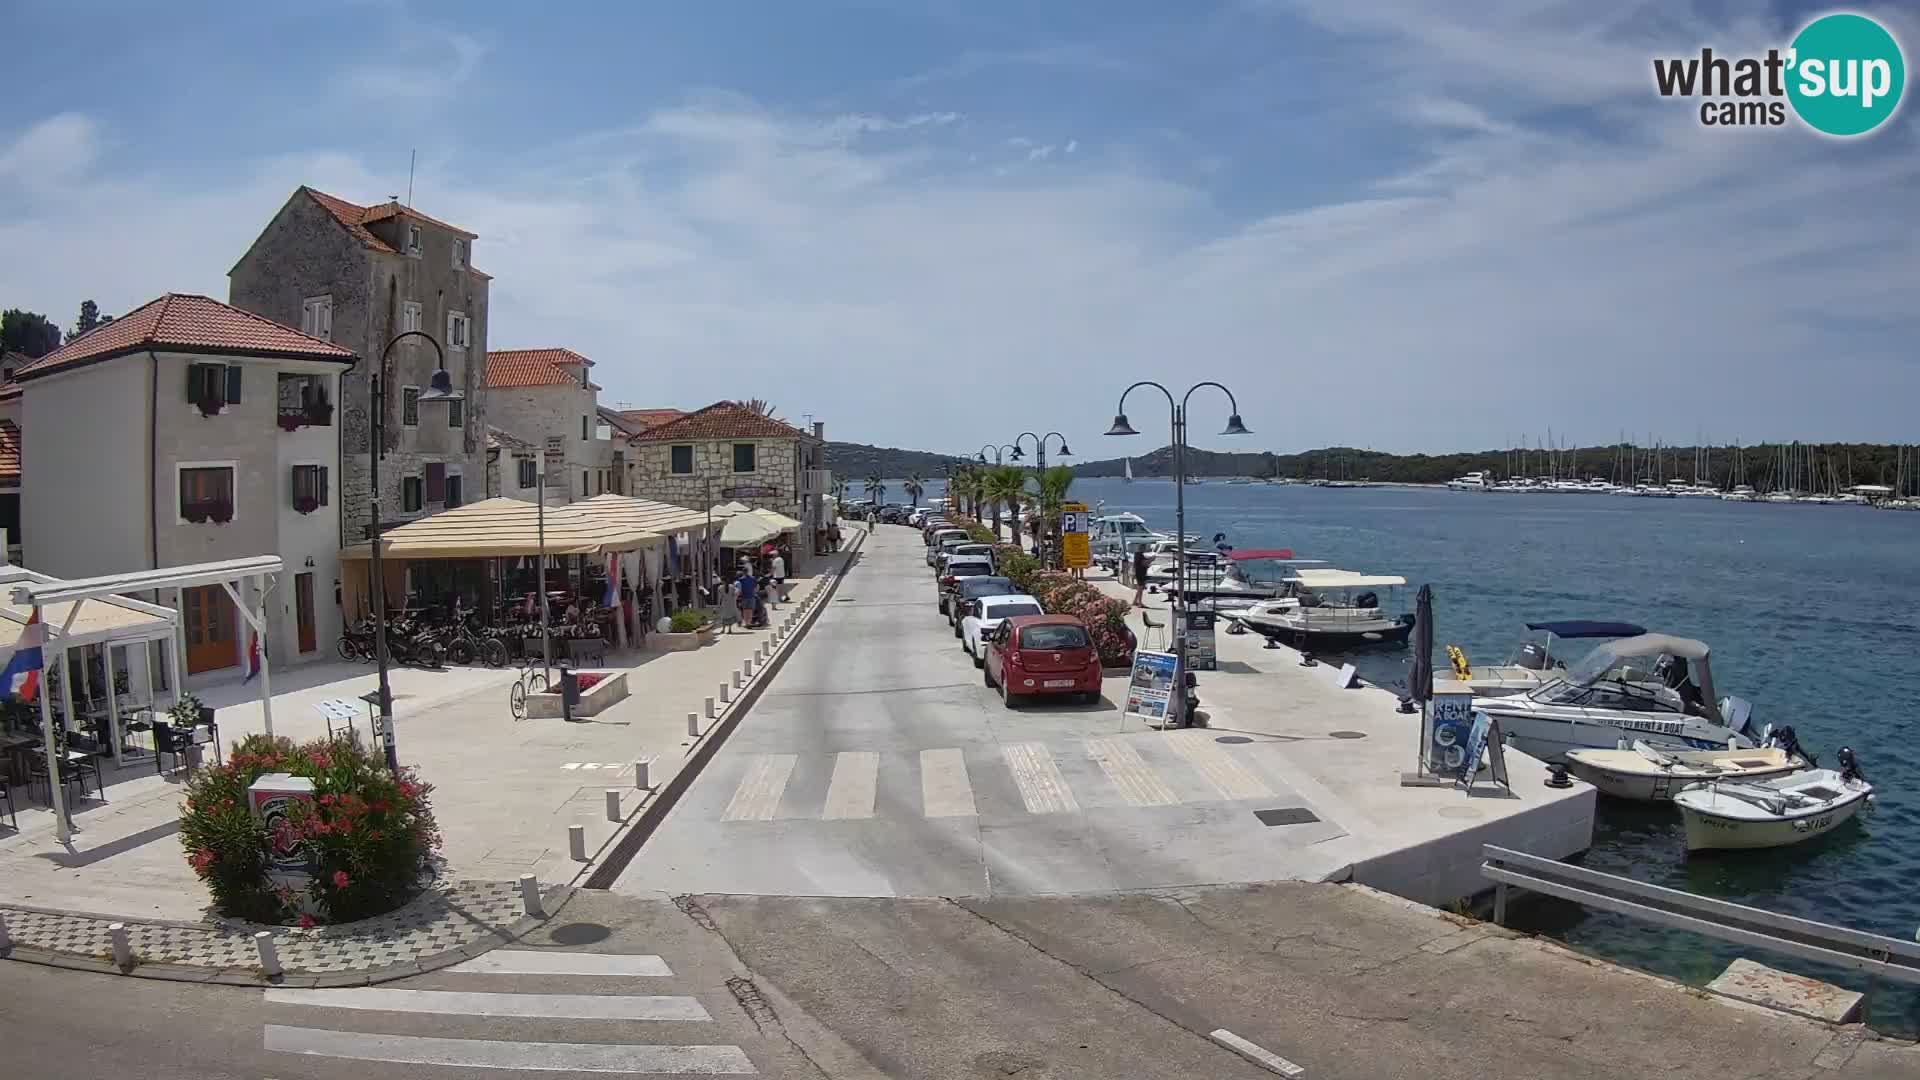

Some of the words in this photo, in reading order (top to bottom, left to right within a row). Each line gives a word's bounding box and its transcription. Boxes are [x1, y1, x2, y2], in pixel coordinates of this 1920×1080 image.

[1065, 514, 1076, 530] P
[1435, 702, 1470, 711] RENT
[1634, 720, 1655, 730] RENT
[1664, 723, 1685, 735] BOAT
